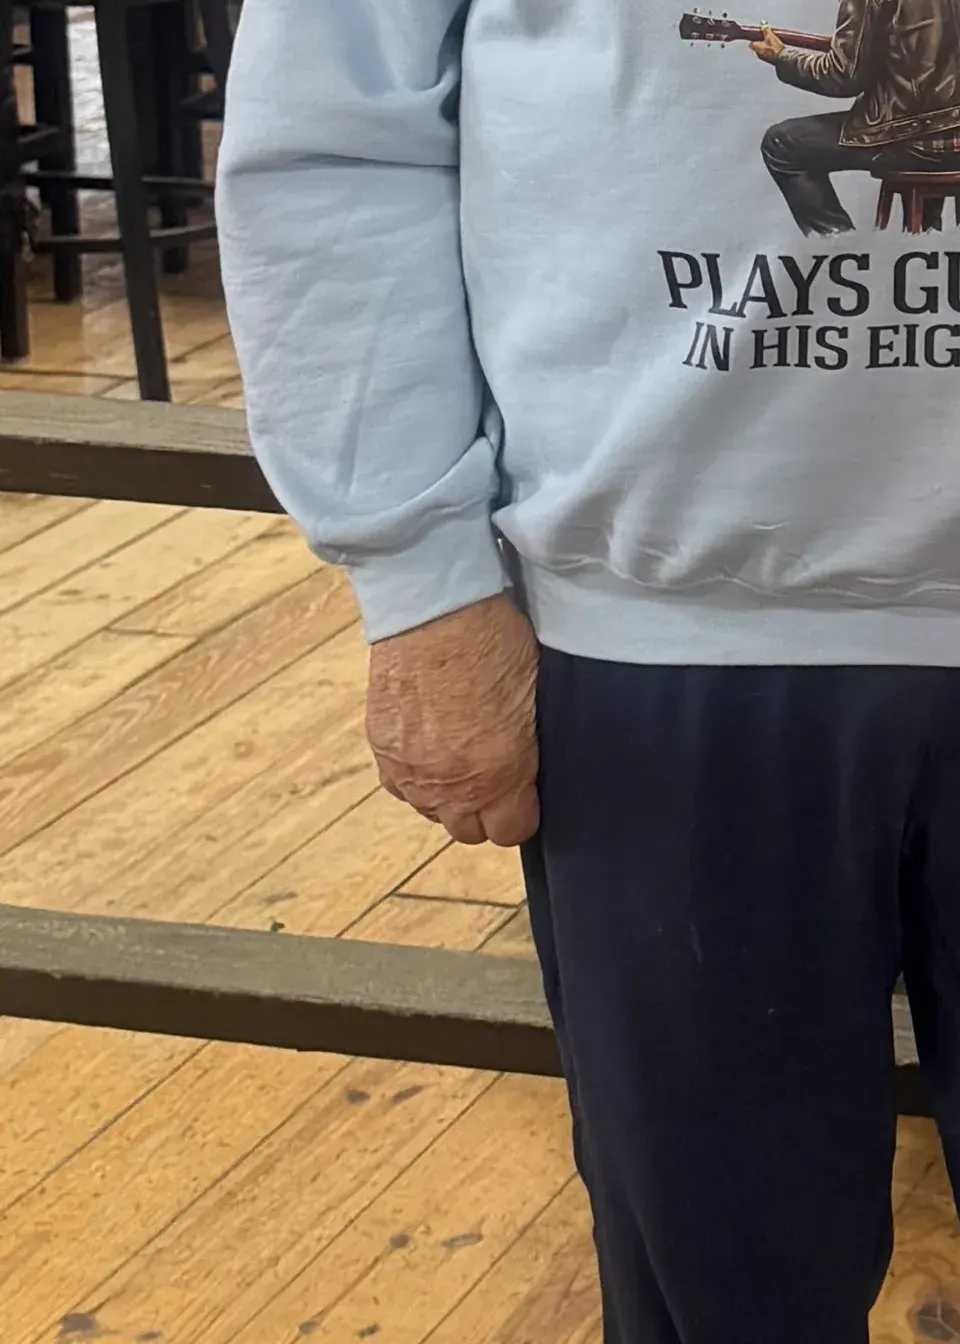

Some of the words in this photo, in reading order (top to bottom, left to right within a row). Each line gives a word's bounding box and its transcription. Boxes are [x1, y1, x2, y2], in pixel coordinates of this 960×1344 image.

[657, 248, 870, 320] PLAYS
[681, 322, 734, 372] IN
[749, 324, 849, 371] HIS
